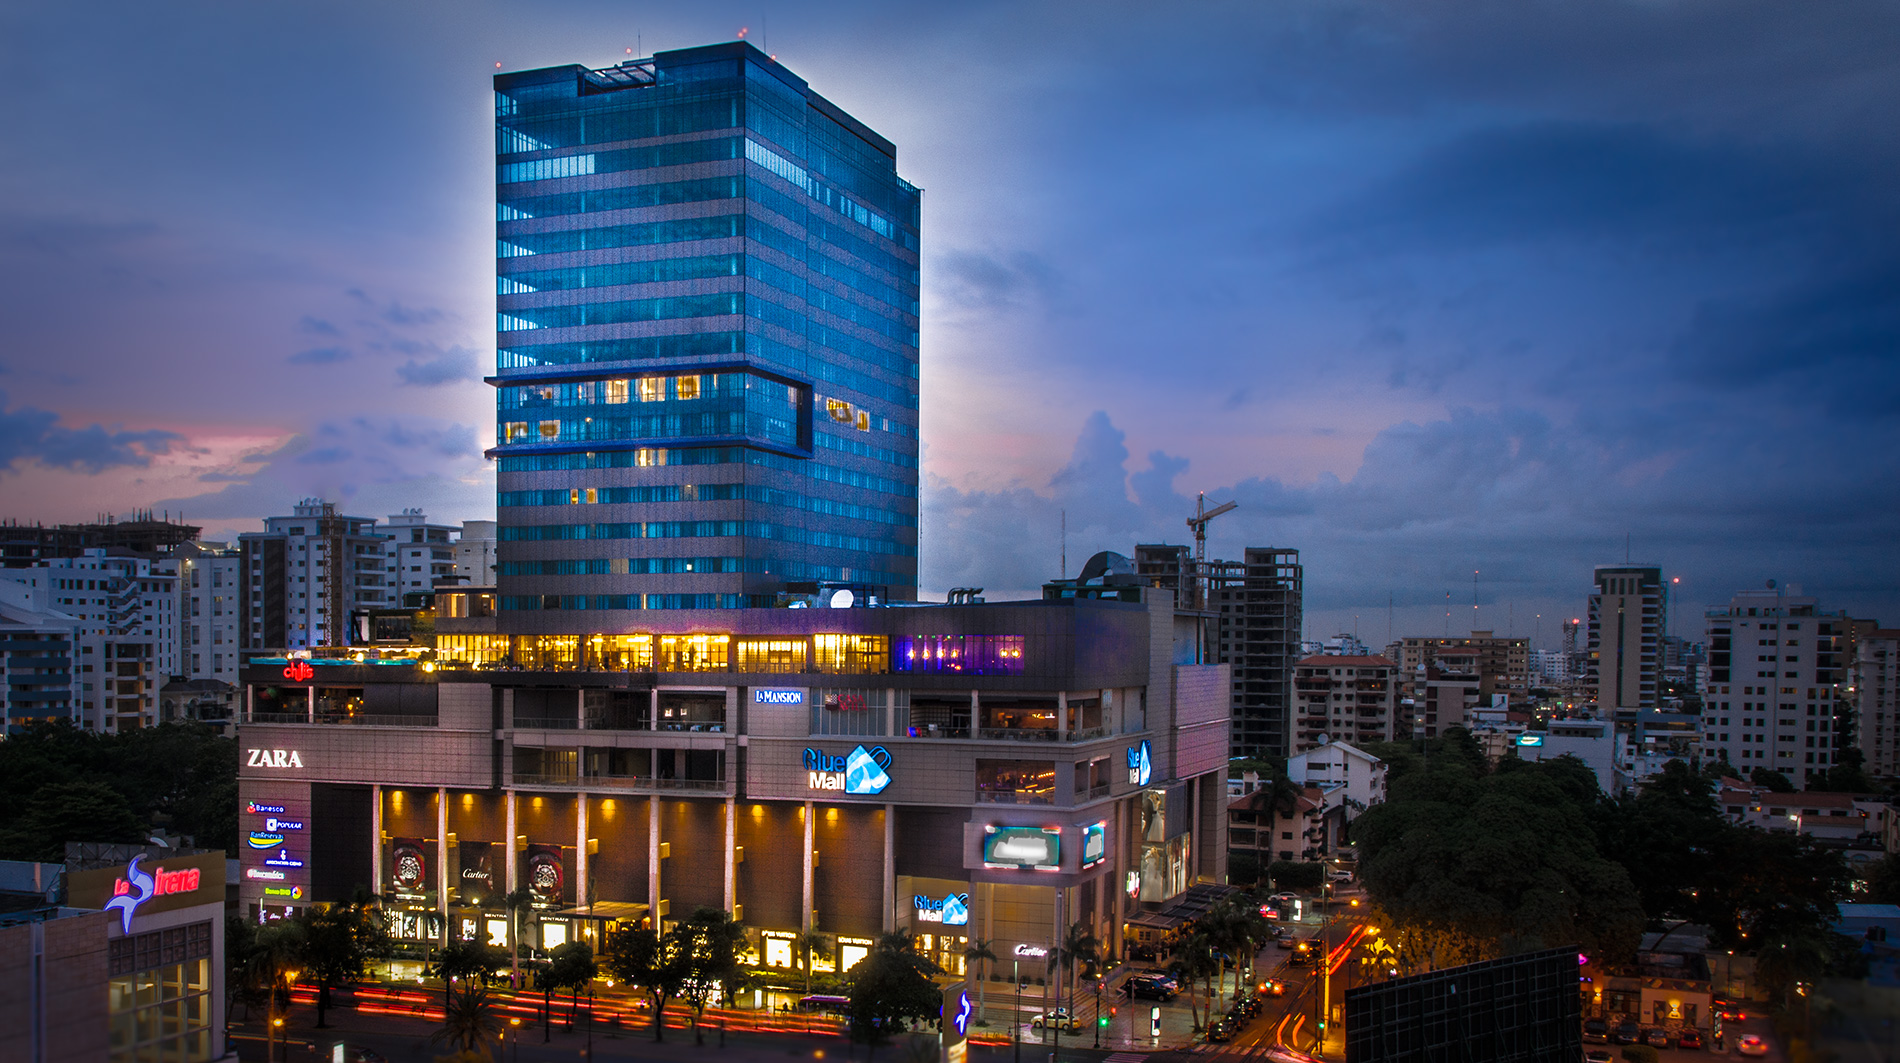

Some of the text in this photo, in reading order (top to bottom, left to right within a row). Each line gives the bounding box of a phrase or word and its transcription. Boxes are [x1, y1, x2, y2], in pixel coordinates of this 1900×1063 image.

[764, 690, 802, 703] MANSION
[837, 693, 864, 702] CASA
[247, 749, 304, 767] ZARA
[802, 747, 846, 772] Blue
[1127, 747, 1140, 768] Blue
[809, 772, 845, 790] Mall
[1128, 768, 1140, 784] Mall
[255, 804, 285, 813] Banesco
[277, 821, 303, 829] POPULAR
[462, 868, 490, 879] Cartier
[913, 894, 943, 911] Blue
[918, 909, 943, 922] Mall
[1014, 943, 1048, 957] Cartier
